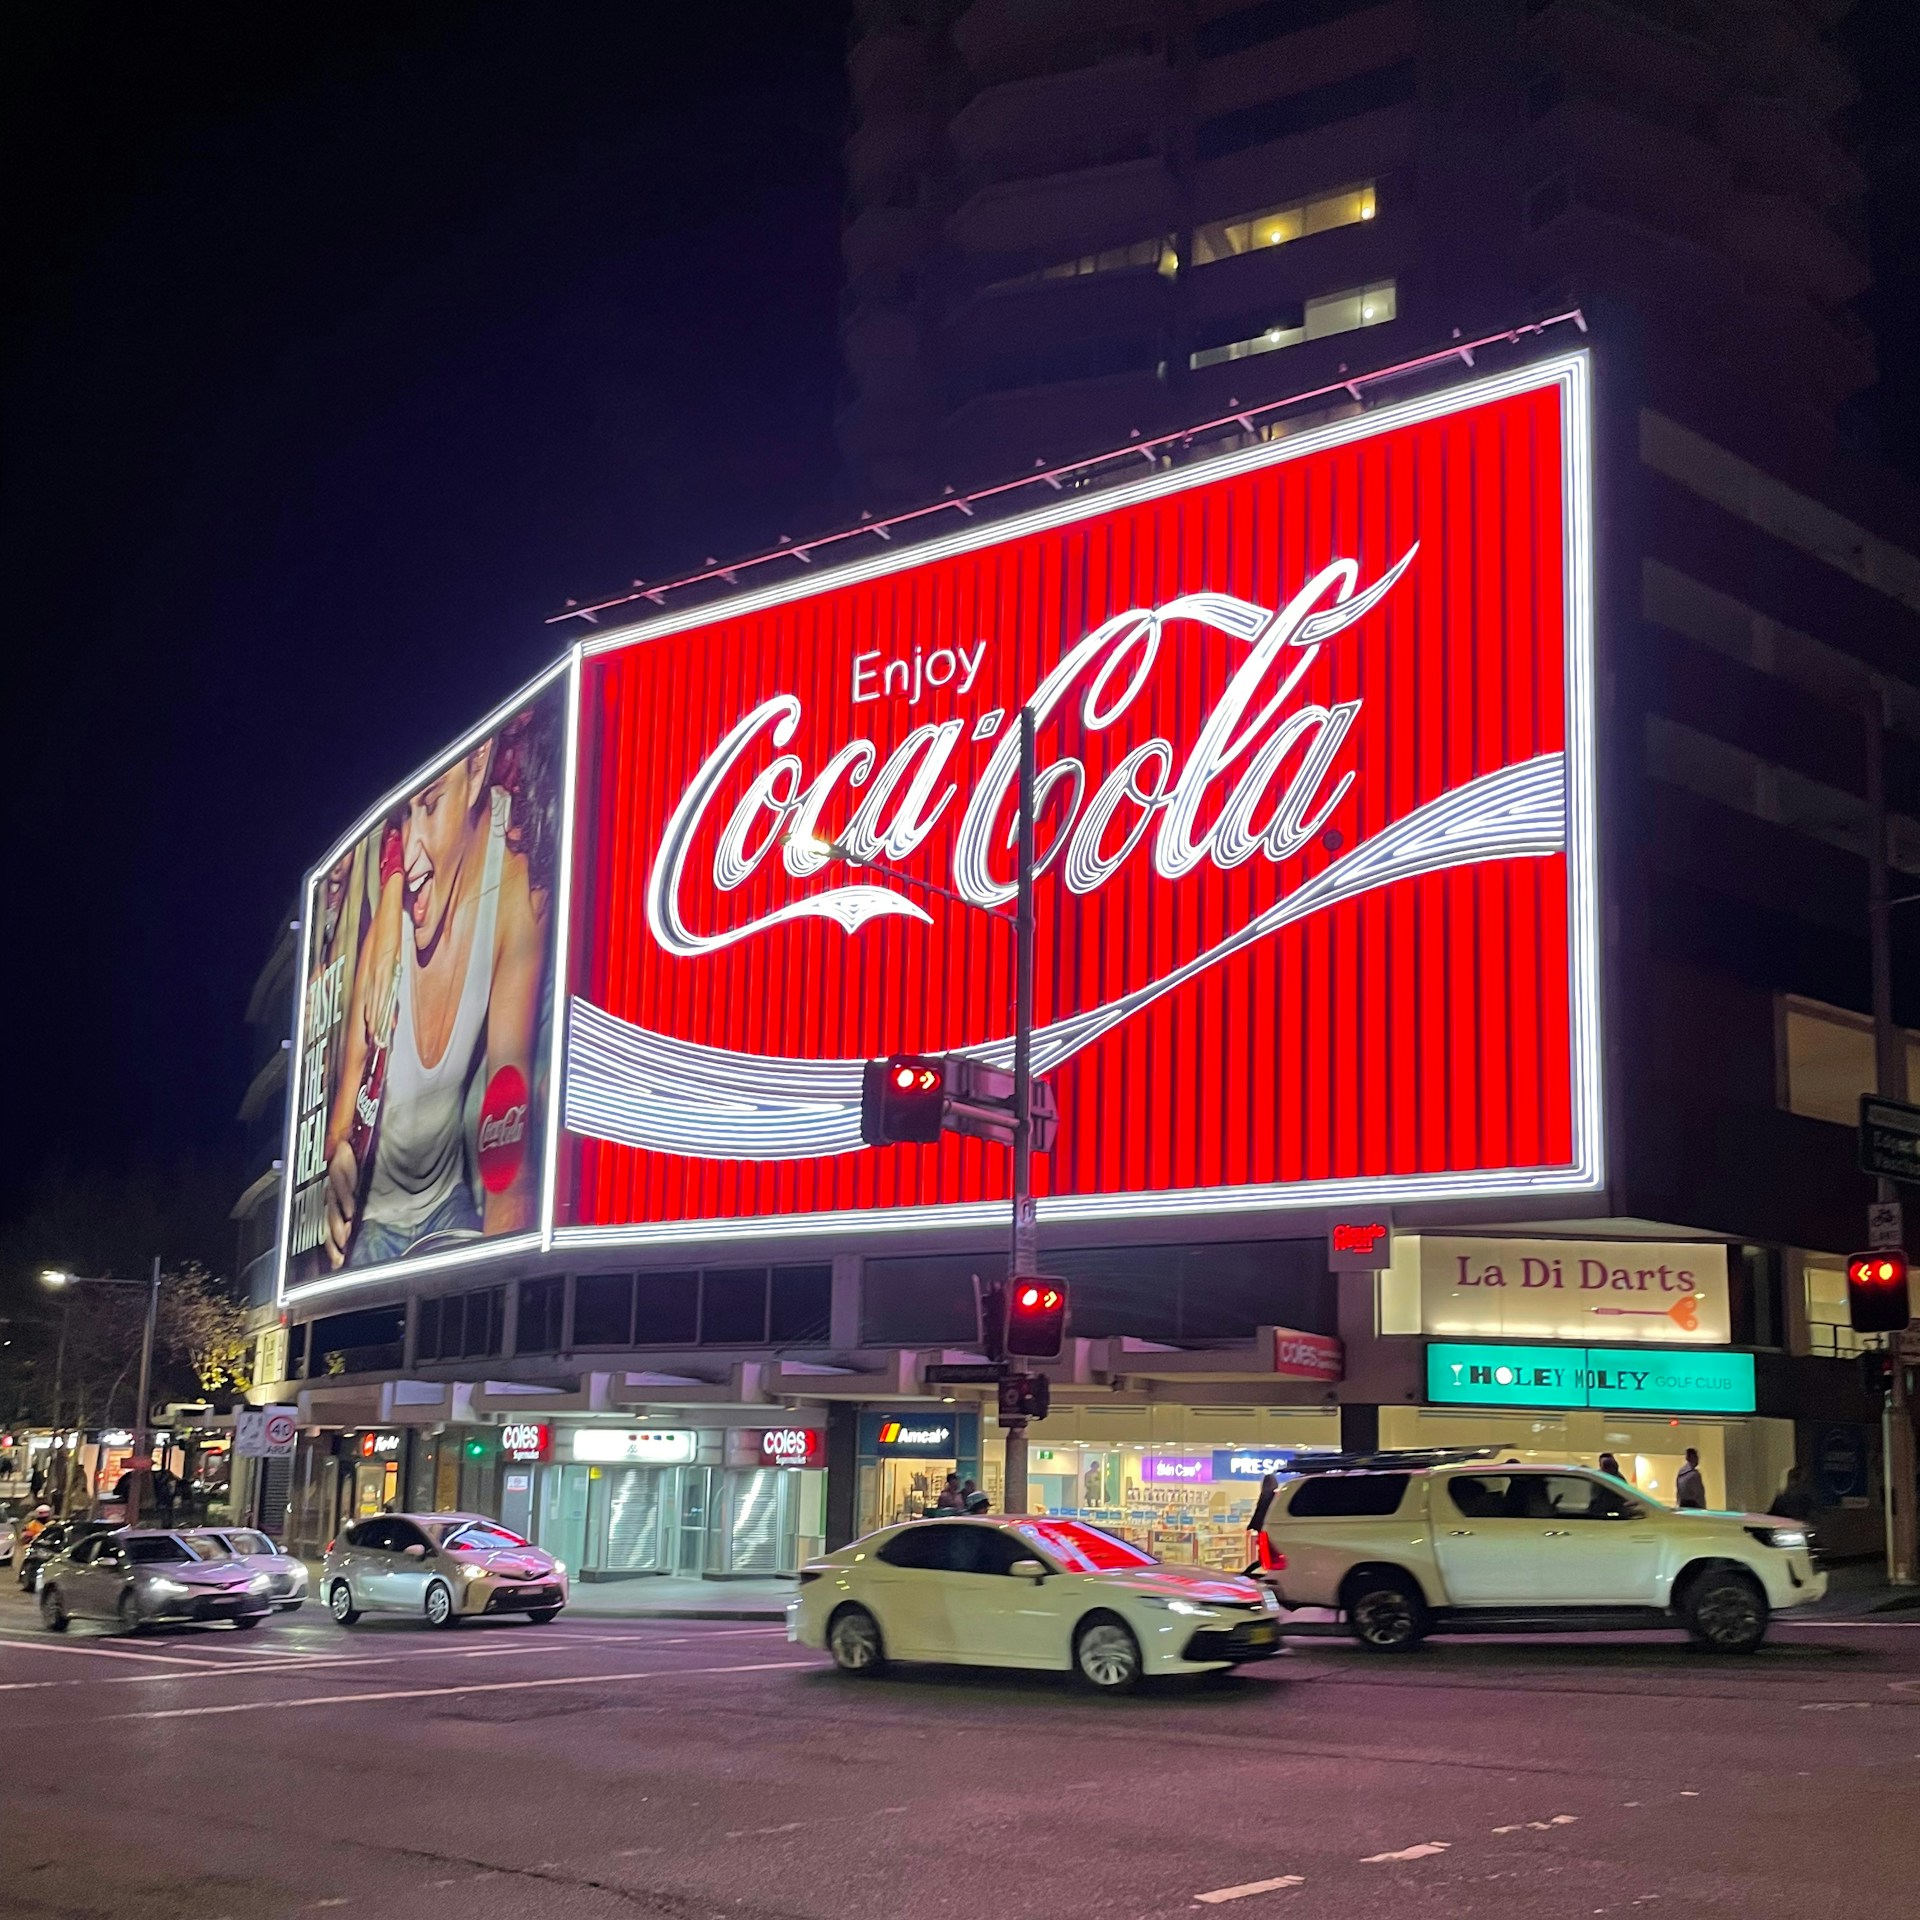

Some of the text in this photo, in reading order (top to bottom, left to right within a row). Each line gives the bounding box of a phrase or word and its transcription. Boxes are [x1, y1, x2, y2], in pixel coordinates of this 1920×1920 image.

[852, 640, 987, 706] Enjoy
[645, 540, 1420, 957] Coca-Cola
[308, 954, 346, 1042] TASTE
[303, 1038, 328, 1116] THE
[296, 1106, 328, 1187] REAL
[1457, 1256, 1696, 1292] La Di Darts
[1280, 1338, 1318, 1367] coles
[1575, 1370, 1649, 1391] MOLEY
[1655, 1376, 1692, 1388] GOLF
[1696, 1377, 1732, 1390] CLUB
[271, 1423, 291, 1437] 40
[502, 1423, 539, 1450] coles
[763, 1428, 806, 1455] coles
[267, 1446, 292, 1455] AREA
